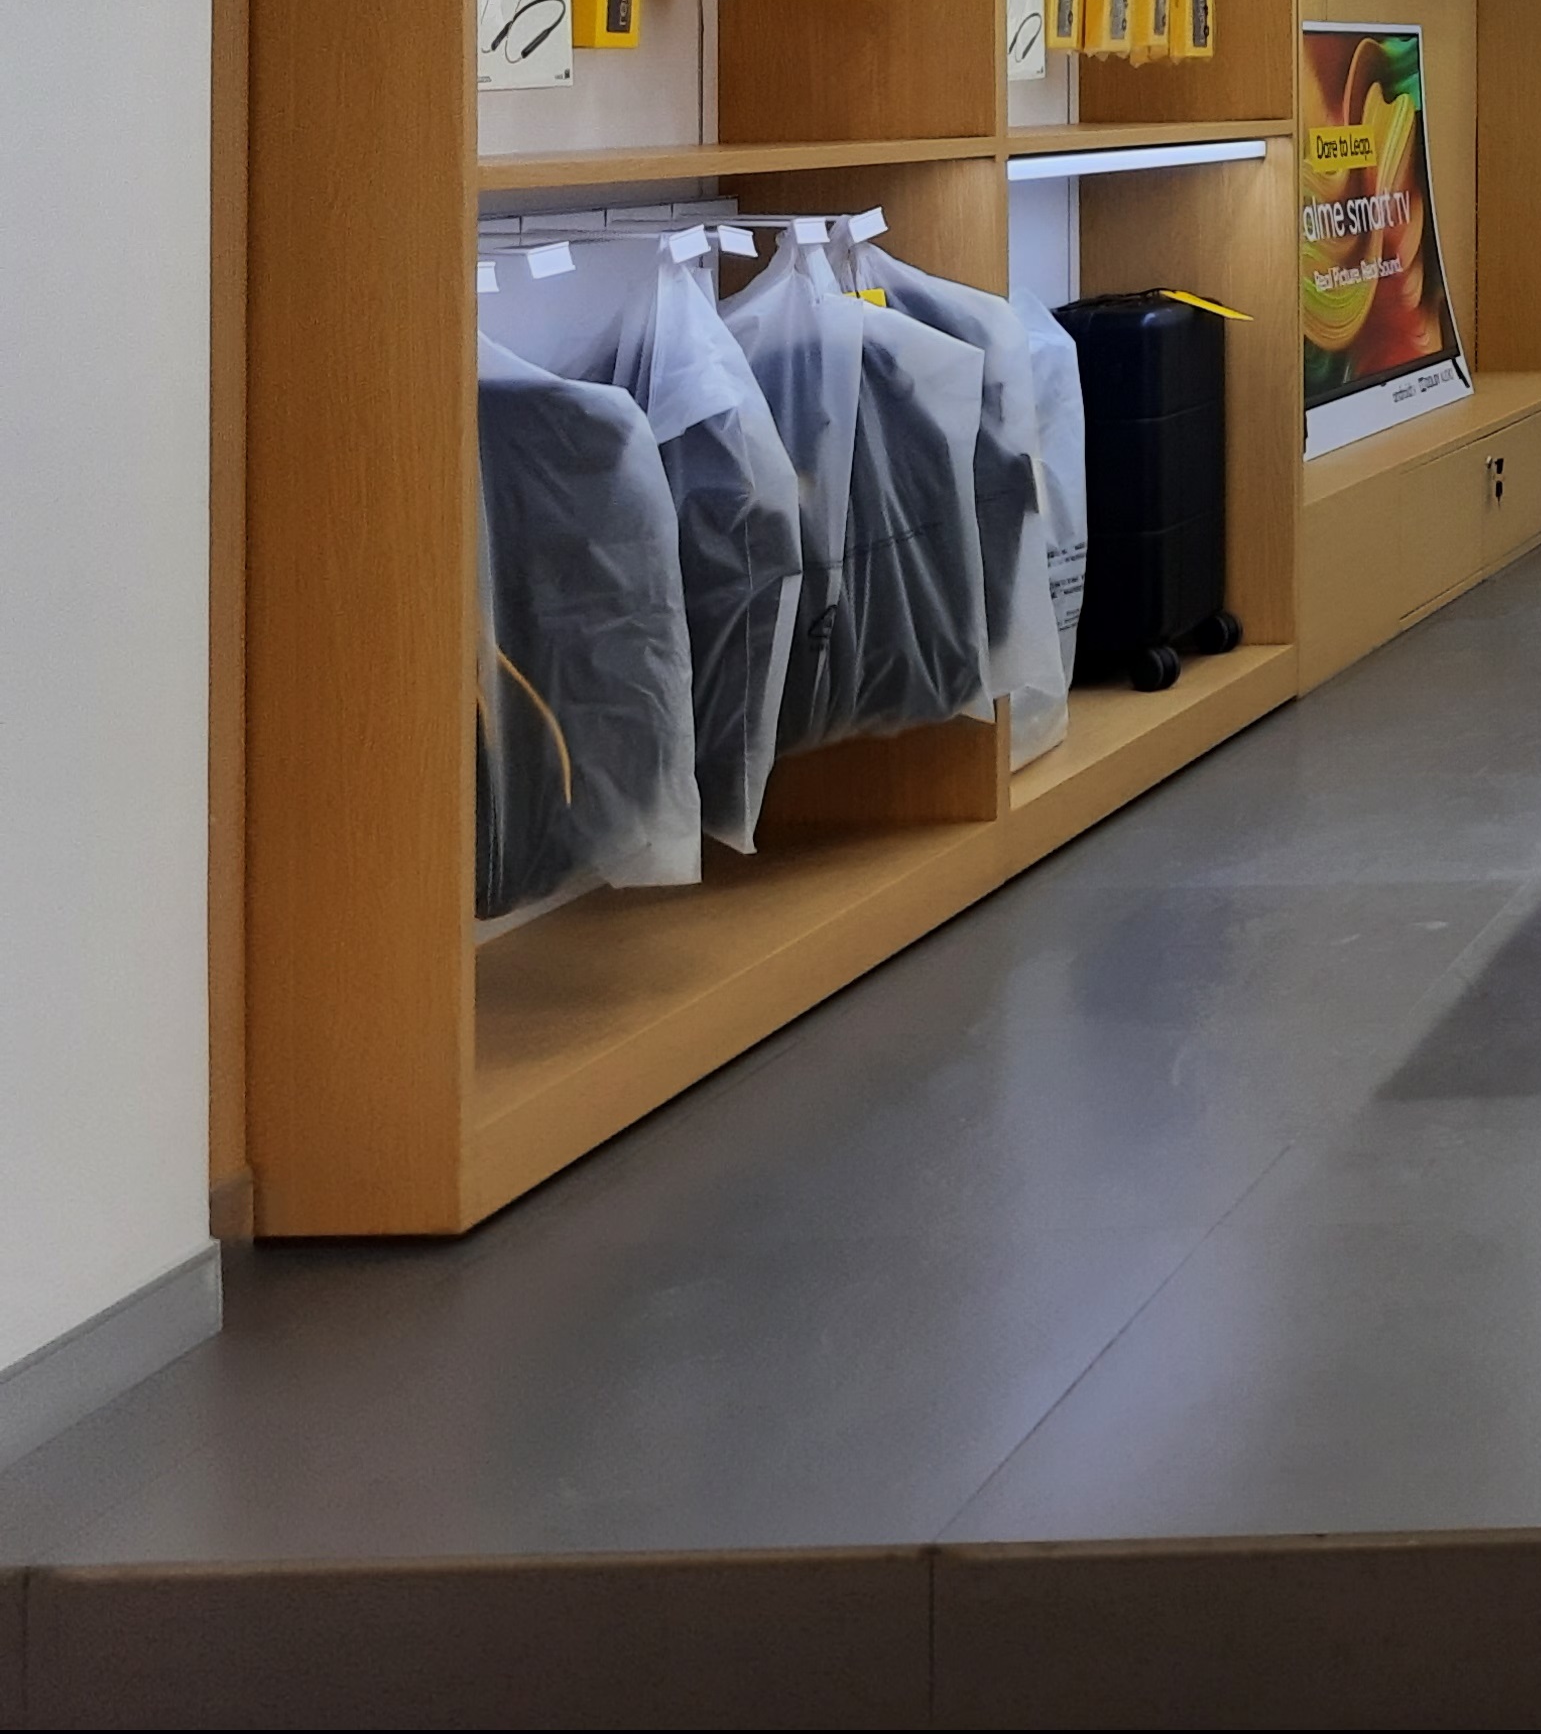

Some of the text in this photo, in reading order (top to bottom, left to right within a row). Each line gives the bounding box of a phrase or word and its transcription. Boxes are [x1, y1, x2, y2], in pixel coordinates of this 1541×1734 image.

[1316, 135, 1338, 160] Dare
[1302, 188, 1411, 242] alme smart TV
